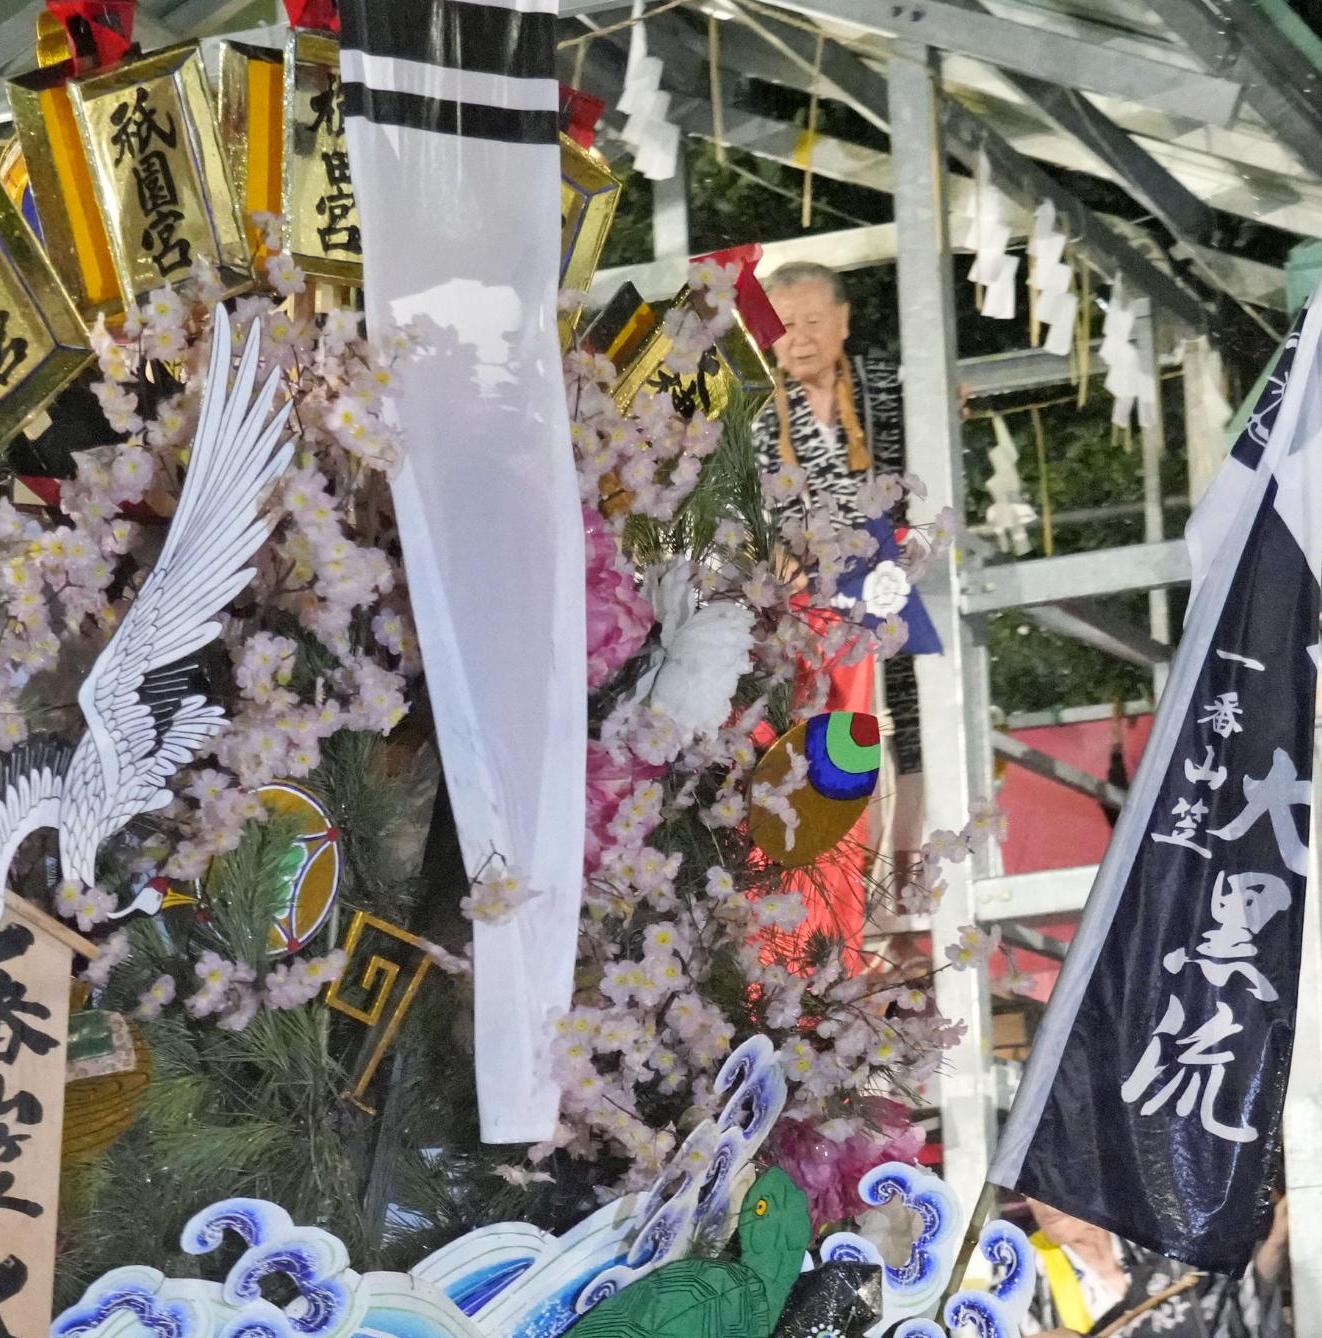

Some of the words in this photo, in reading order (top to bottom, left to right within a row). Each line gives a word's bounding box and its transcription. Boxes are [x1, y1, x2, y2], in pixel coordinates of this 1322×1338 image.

[1151, 647, 1267, 859] 一番山笠
[1121, 747, 1313, 1143] 大黒流
